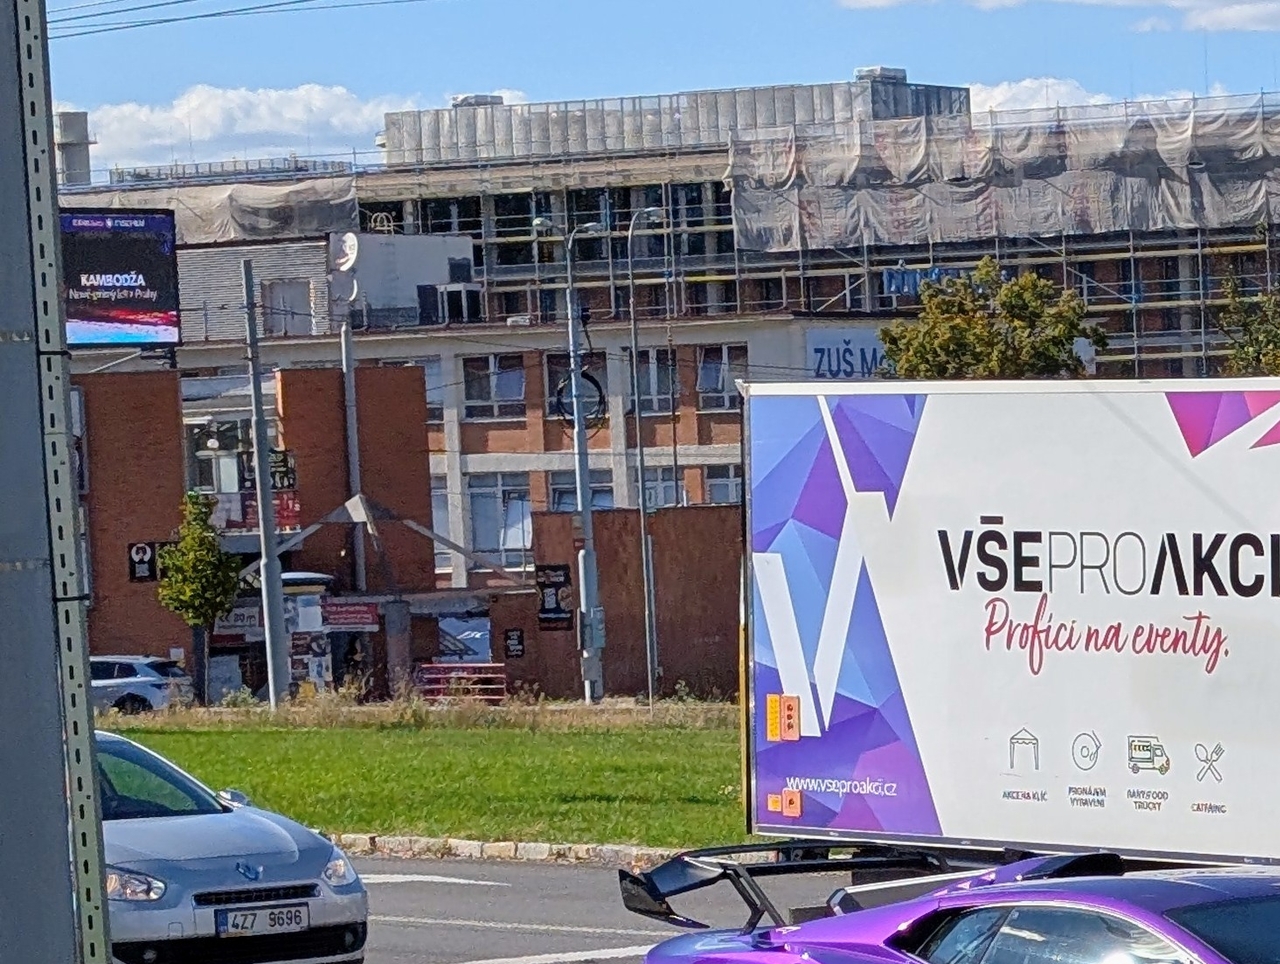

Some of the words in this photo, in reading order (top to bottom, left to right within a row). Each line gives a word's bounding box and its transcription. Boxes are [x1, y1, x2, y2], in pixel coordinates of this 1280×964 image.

[79, 270, 146, 287] KAMBODŽA
[813, 339, 855, 378] ZUŠ
[1084, 619, 1128, 653] na
[1132, 610, 1230, 675] eventy.
[231, 913, 257, 931] 4Z7
[268, 909, 303, 928] 9696
